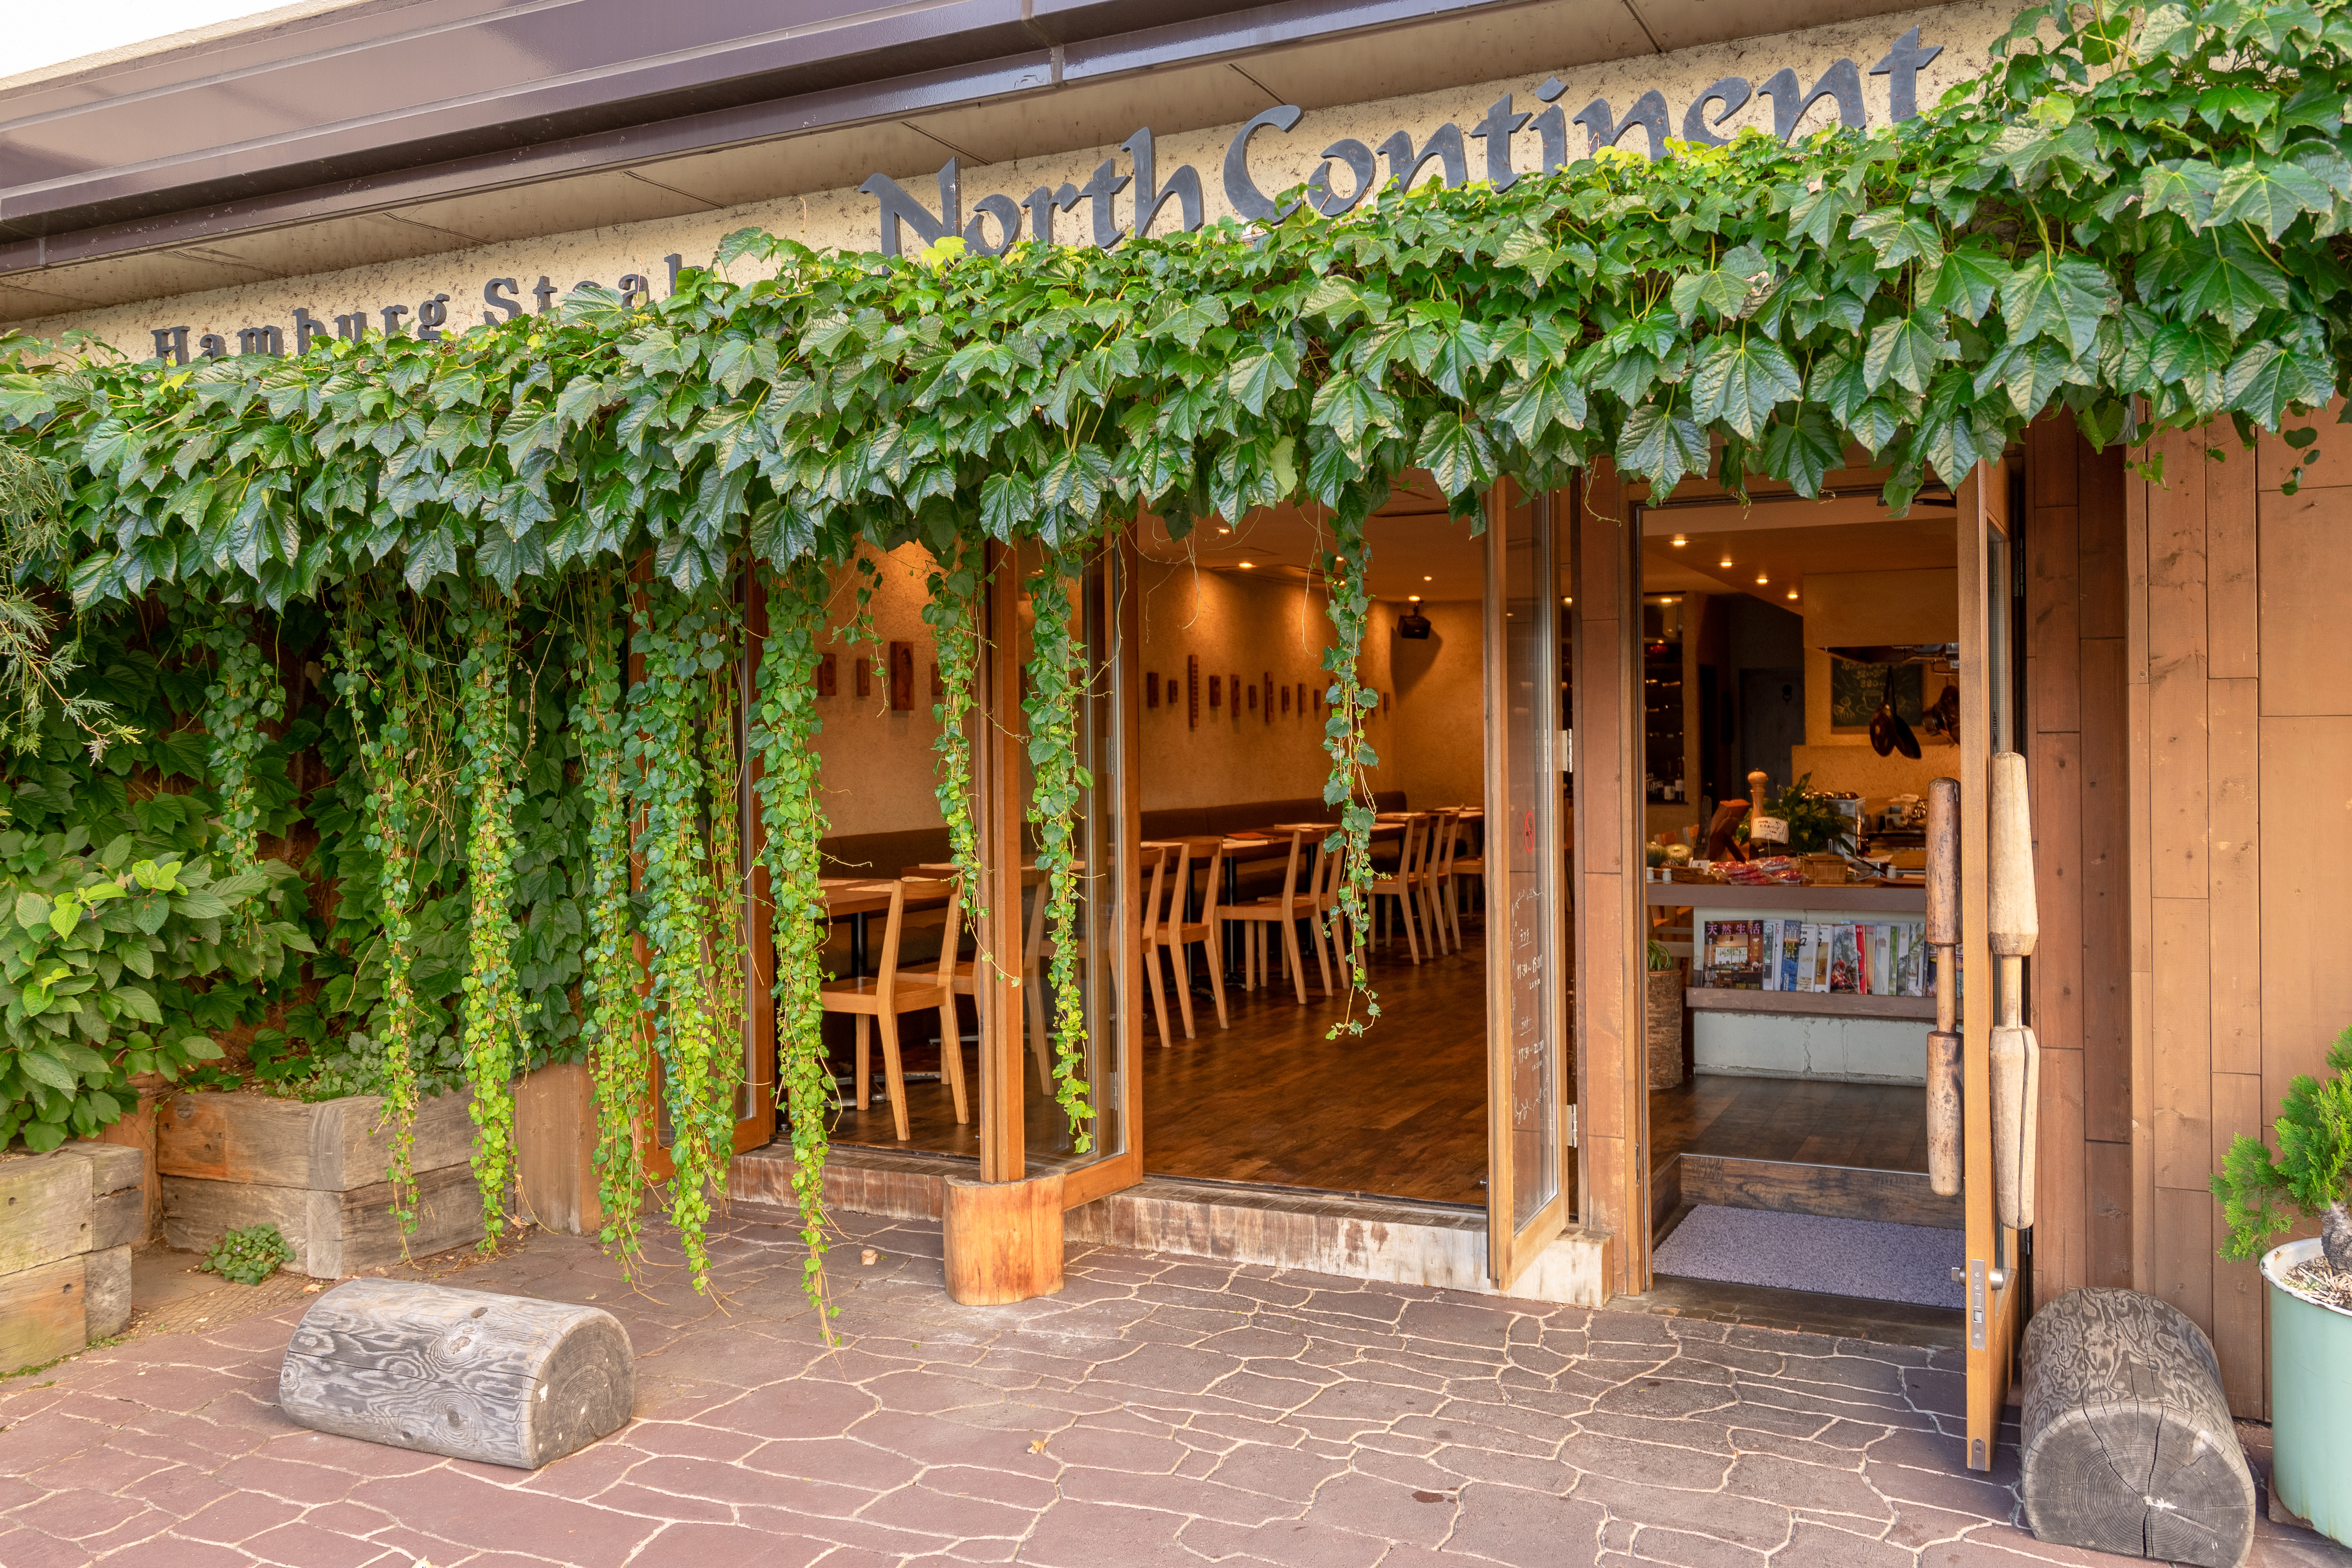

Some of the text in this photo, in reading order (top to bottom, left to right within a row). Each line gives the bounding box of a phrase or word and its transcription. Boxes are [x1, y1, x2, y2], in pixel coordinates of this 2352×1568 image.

[859, 24, 1944, 275] North Continent
[151, 253, 705, 367] Hamburg Sta
[1707, 923, 1761, 935] 天然生活
